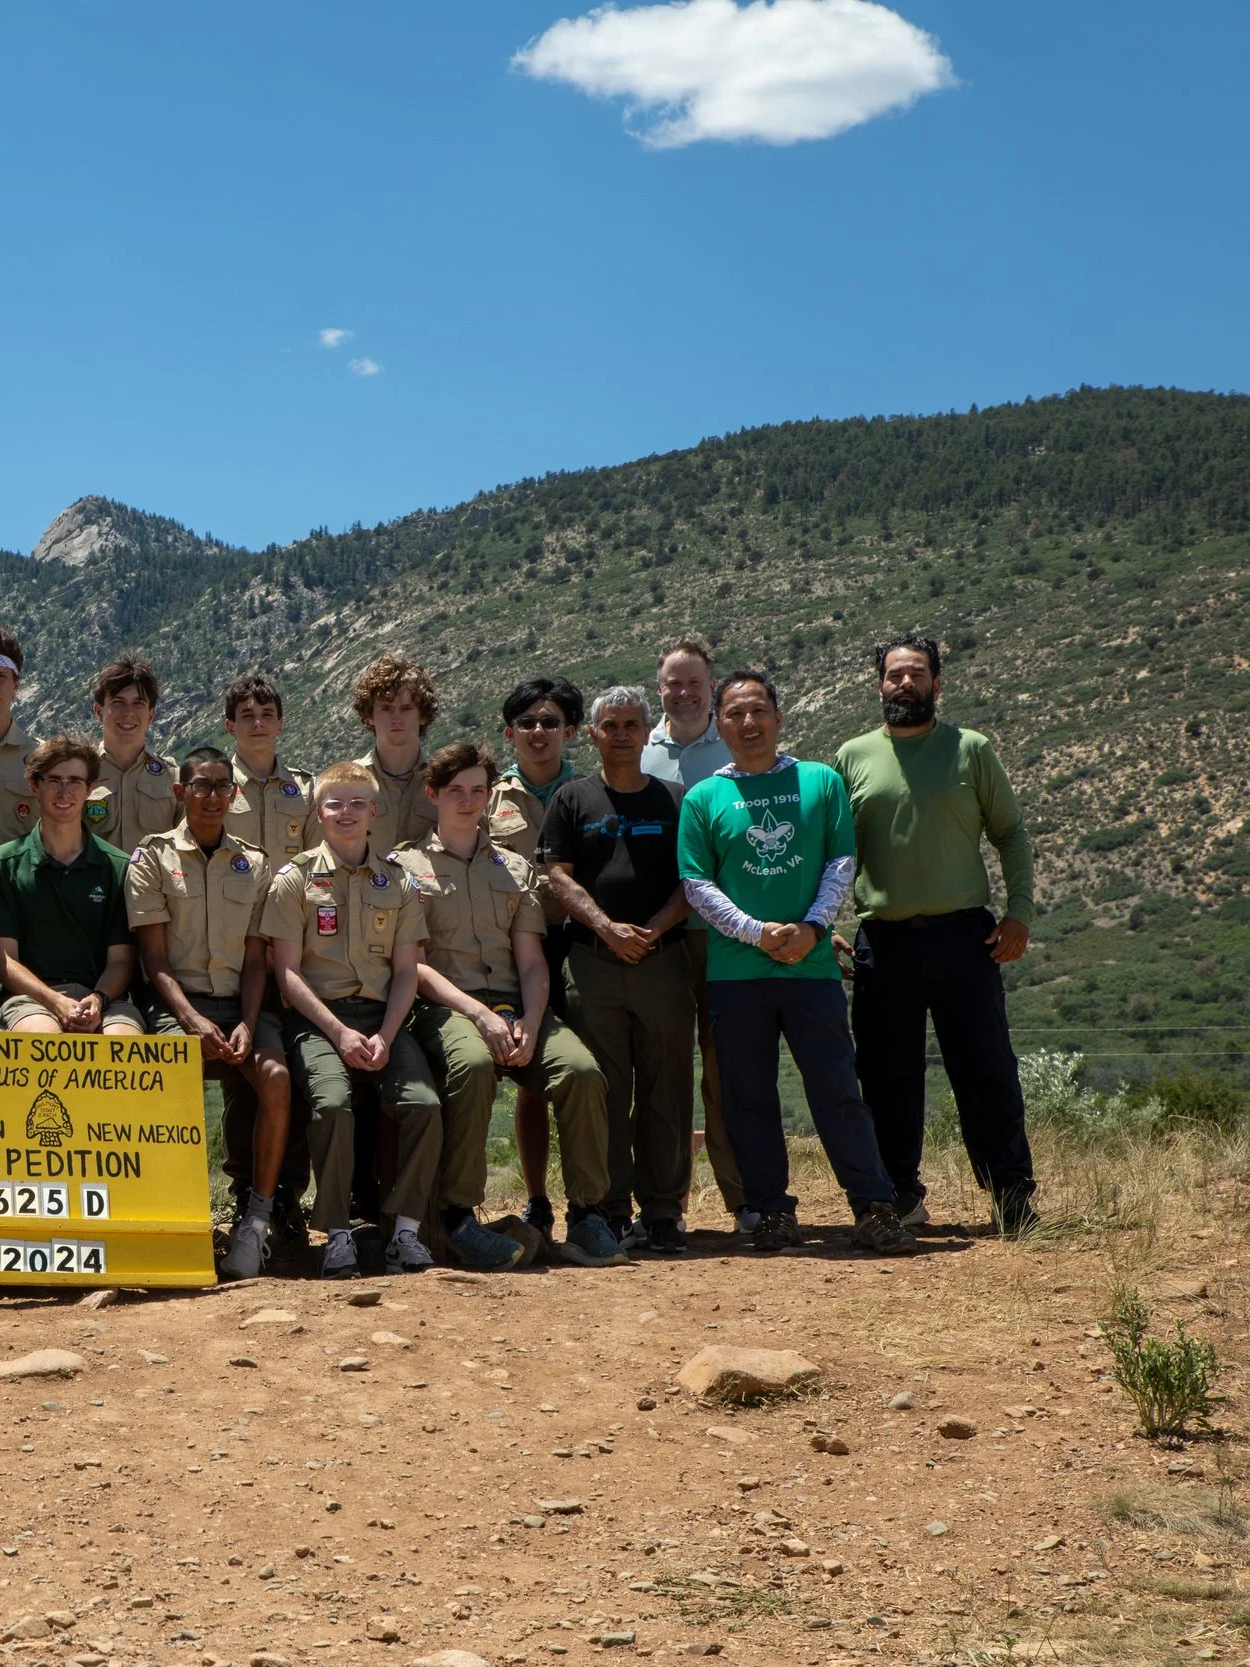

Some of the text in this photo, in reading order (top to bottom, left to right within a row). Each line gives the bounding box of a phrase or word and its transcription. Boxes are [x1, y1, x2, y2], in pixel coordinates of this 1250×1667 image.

[732, 793, 800, 810] Troop 1916
[742, 854, 804, 876] McLean, VA
[30, 1039, 99, 1062] SCOUT
[110, 1040, 188, 1064] RANCH
[63, 1068, 164, 1092] AMERICA
[87, 1122, 132, 1143] NEW
[138, 1124, 201, 1145] MEXICO
[86, 1190, 105, 1217] D
[2, 1245, 103, 1274] 2024
